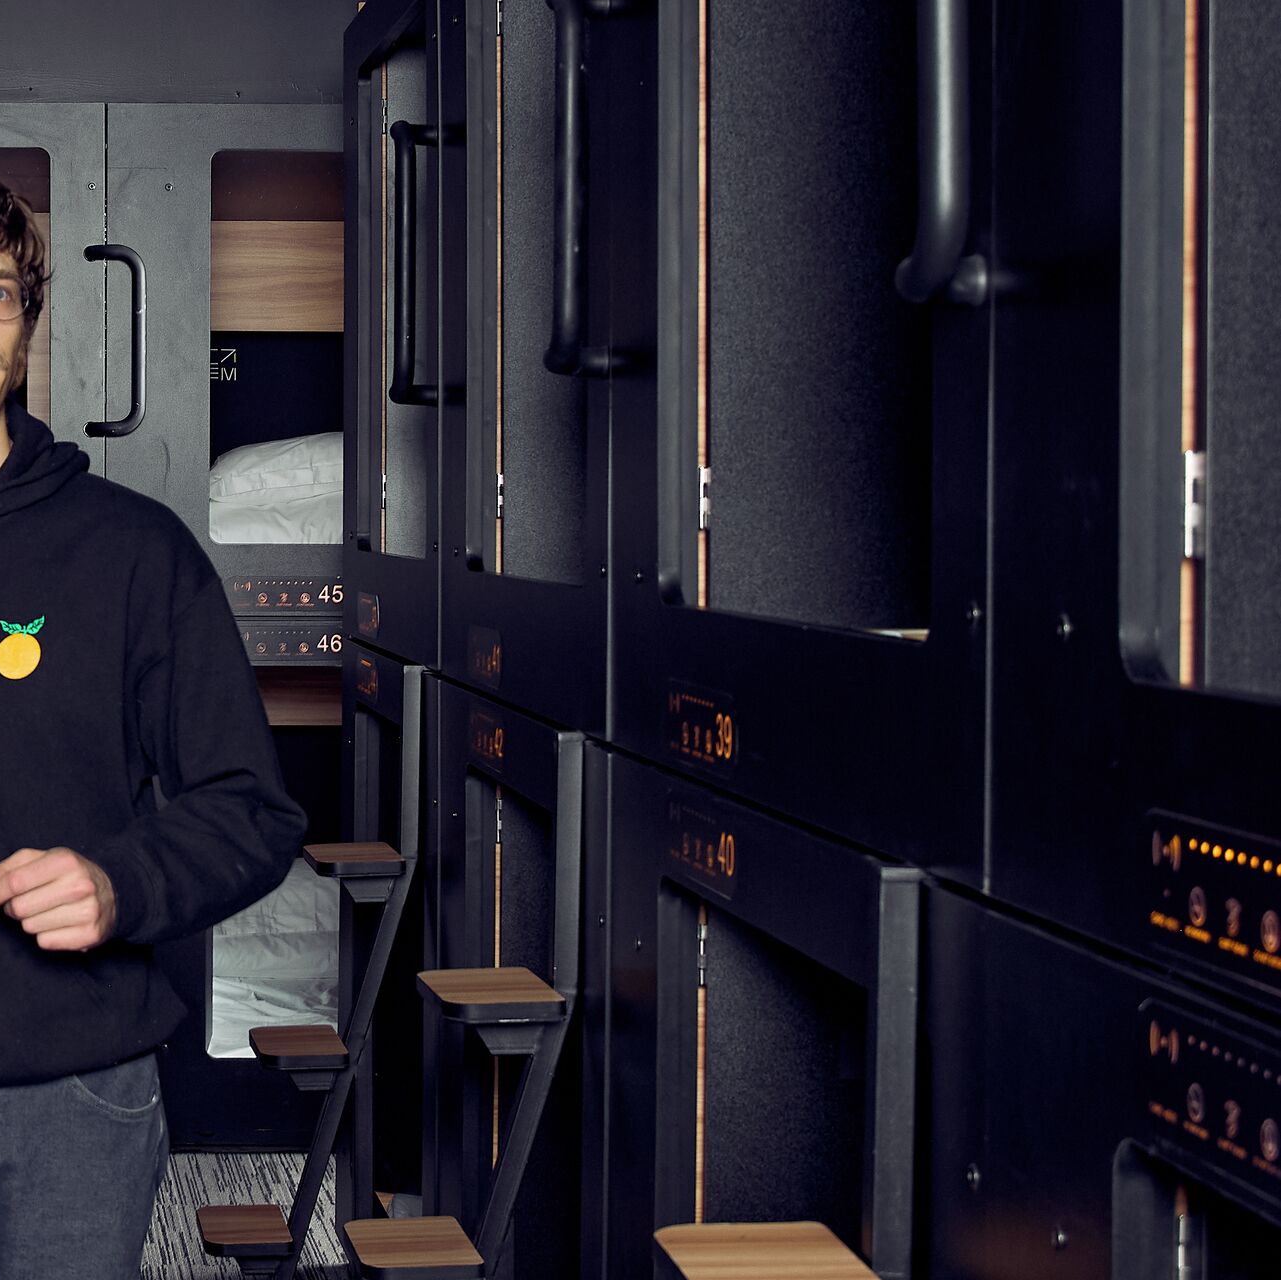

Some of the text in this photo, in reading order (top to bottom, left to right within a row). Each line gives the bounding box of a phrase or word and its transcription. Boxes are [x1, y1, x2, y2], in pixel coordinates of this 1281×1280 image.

[318, 584, 344, 603] 45
[316, 634, 343, 653] 46
[715, 713, 733, 759] 39
[717, 832, 735, 877] 40
